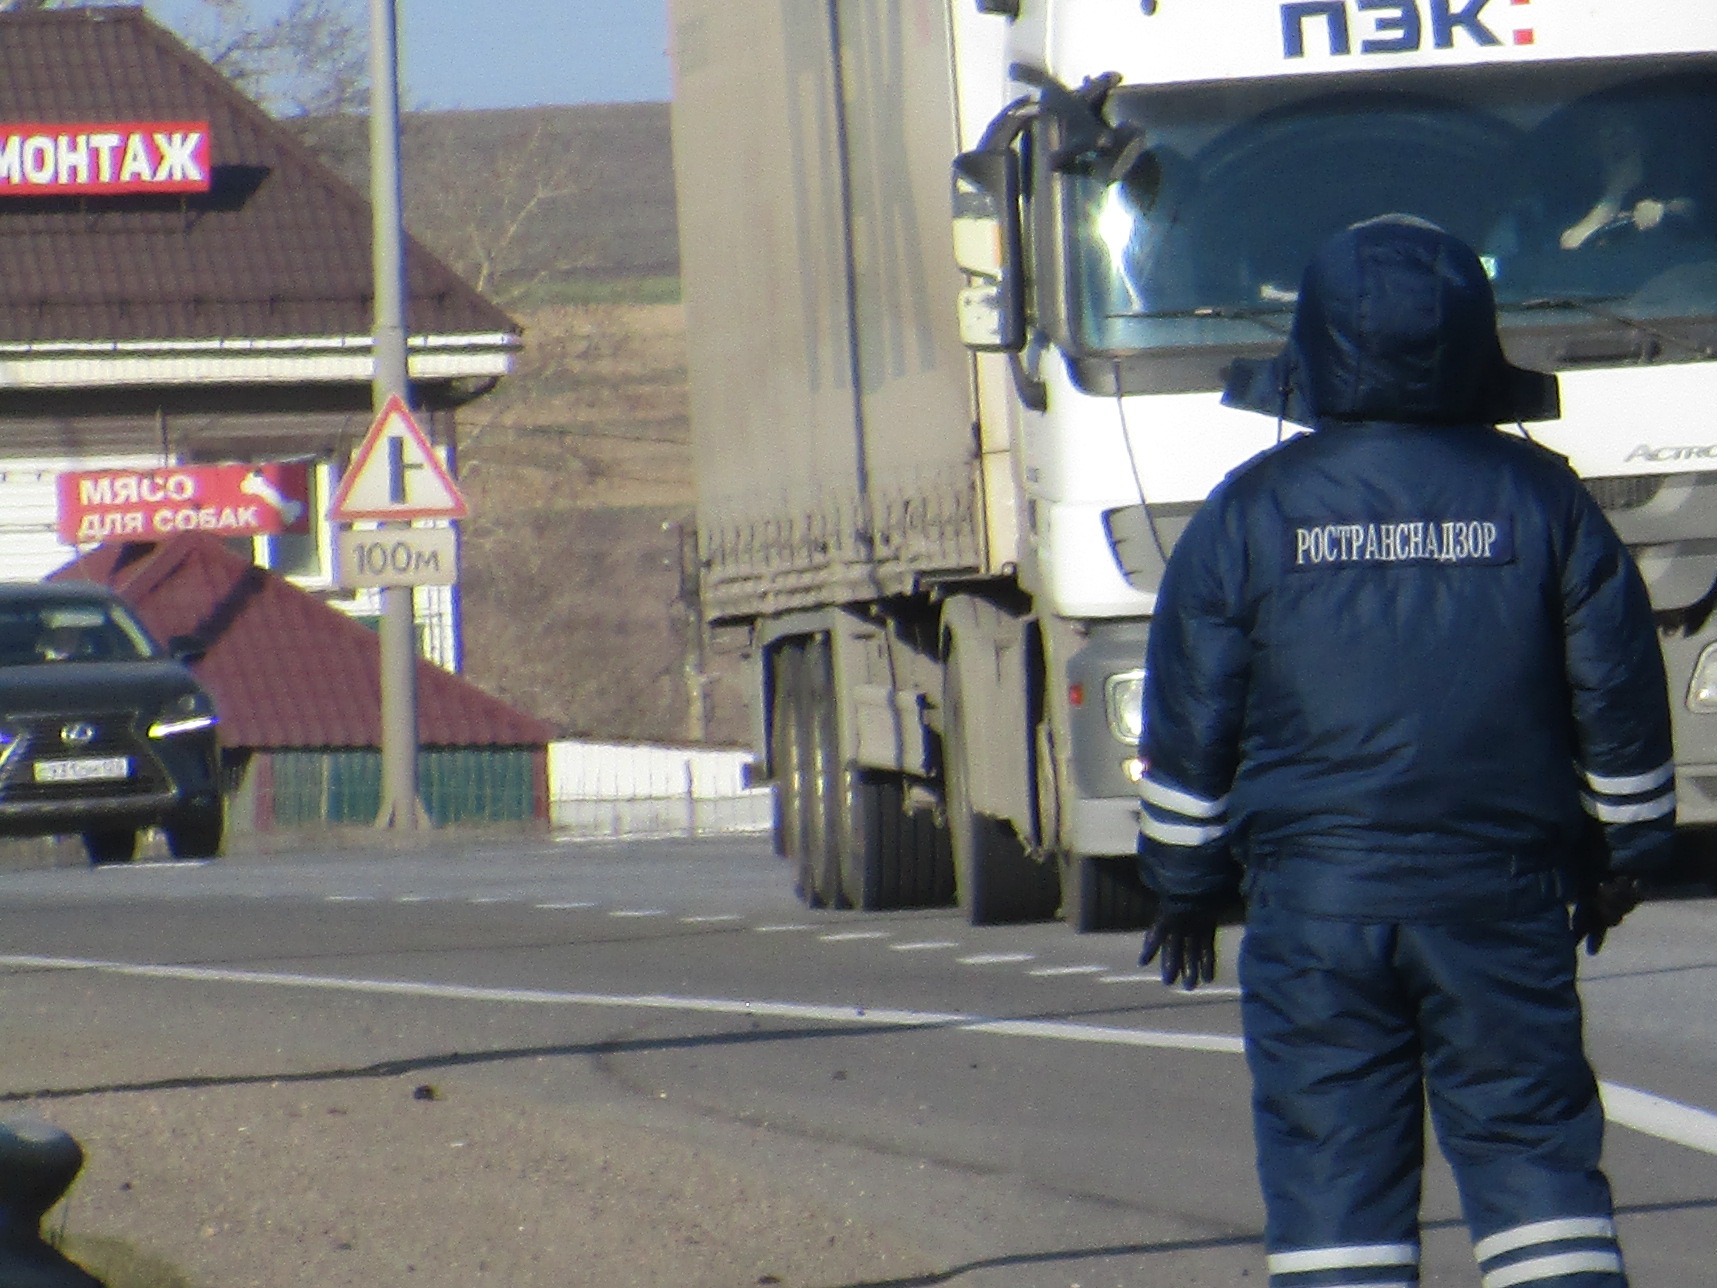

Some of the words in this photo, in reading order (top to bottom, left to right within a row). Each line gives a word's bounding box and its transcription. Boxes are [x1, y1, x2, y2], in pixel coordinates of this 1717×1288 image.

[79, 474, 196, 506] МЯСО
[77, 512, 144, 540] ДЛЯ
[152, 506, 260, 533] СОБАК
[1296, 521, 1498, 564] РОСТРАНСНАДЗОР
